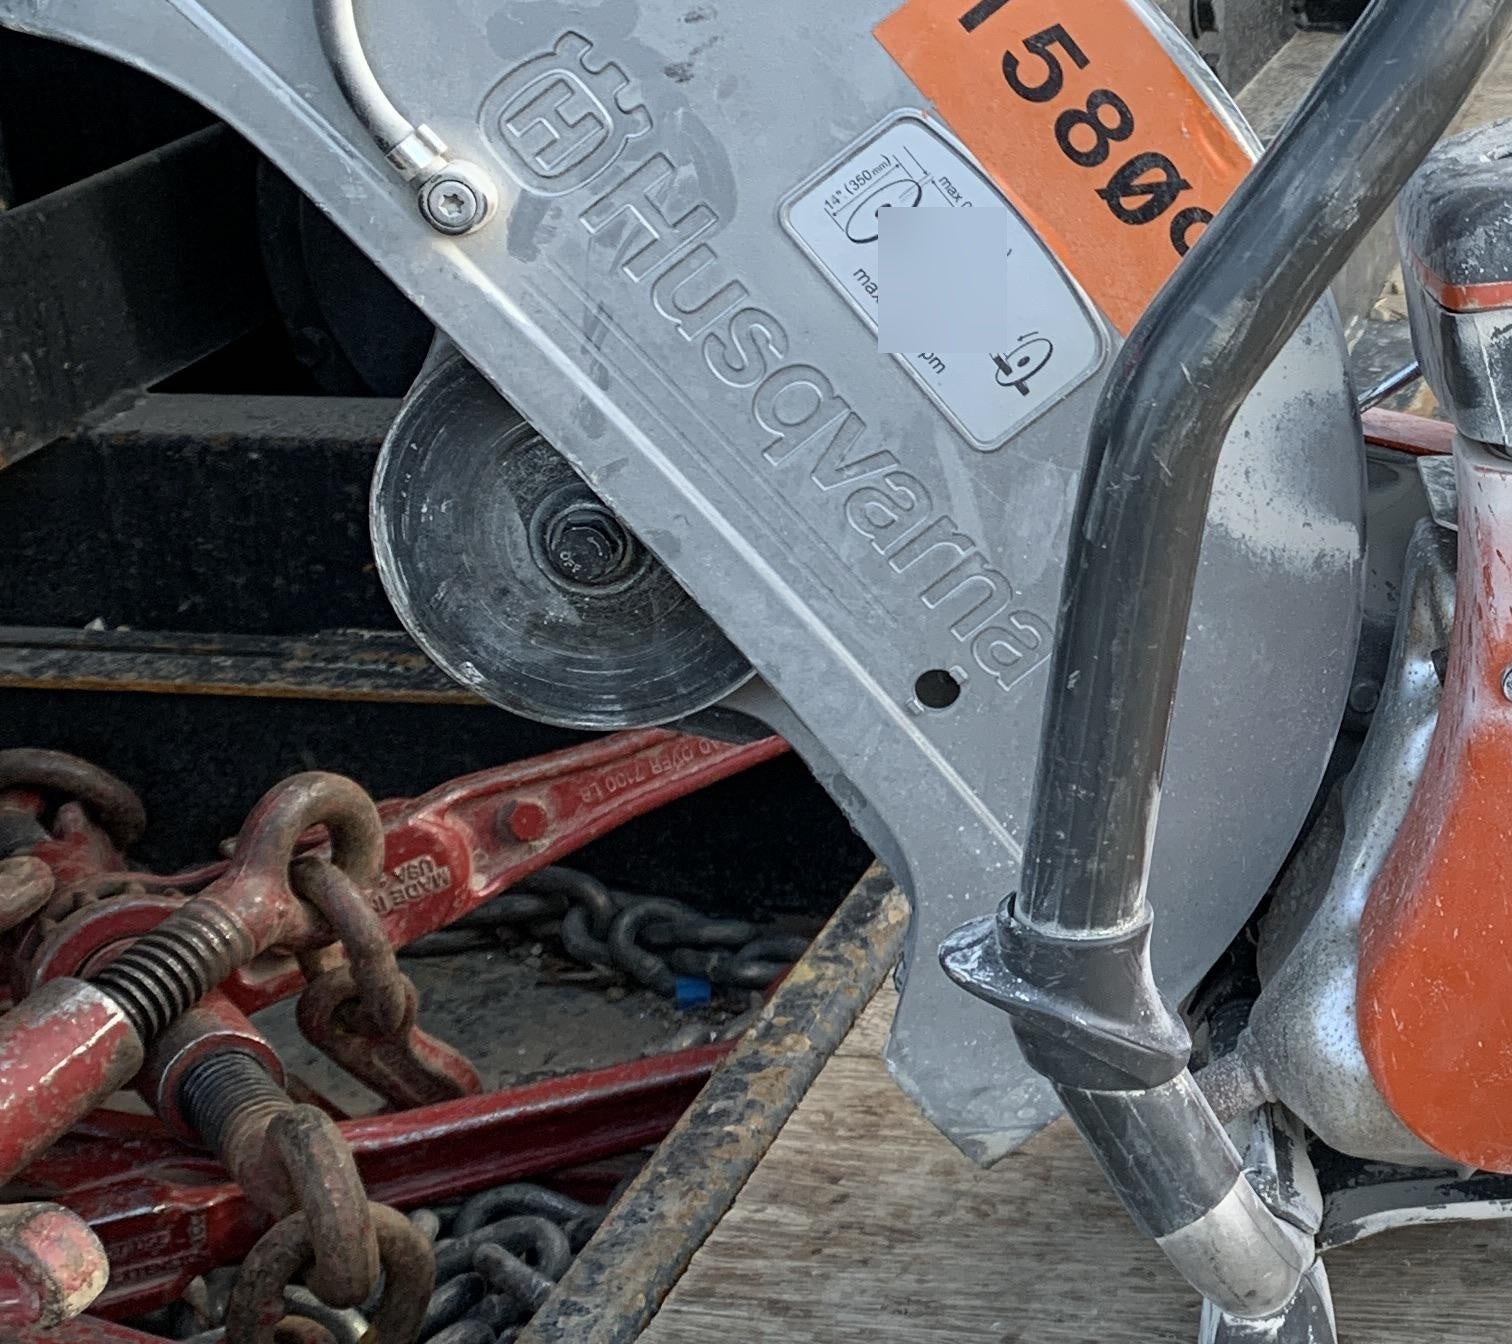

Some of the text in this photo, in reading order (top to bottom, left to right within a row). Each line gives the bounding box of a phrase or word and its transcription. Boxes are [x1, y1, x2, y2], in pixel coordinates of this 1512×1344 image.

[938, 175, 963, 203] max
[579, 152, 1052, 691] Husqvarna
[389, 866, 449, 906] MADE
